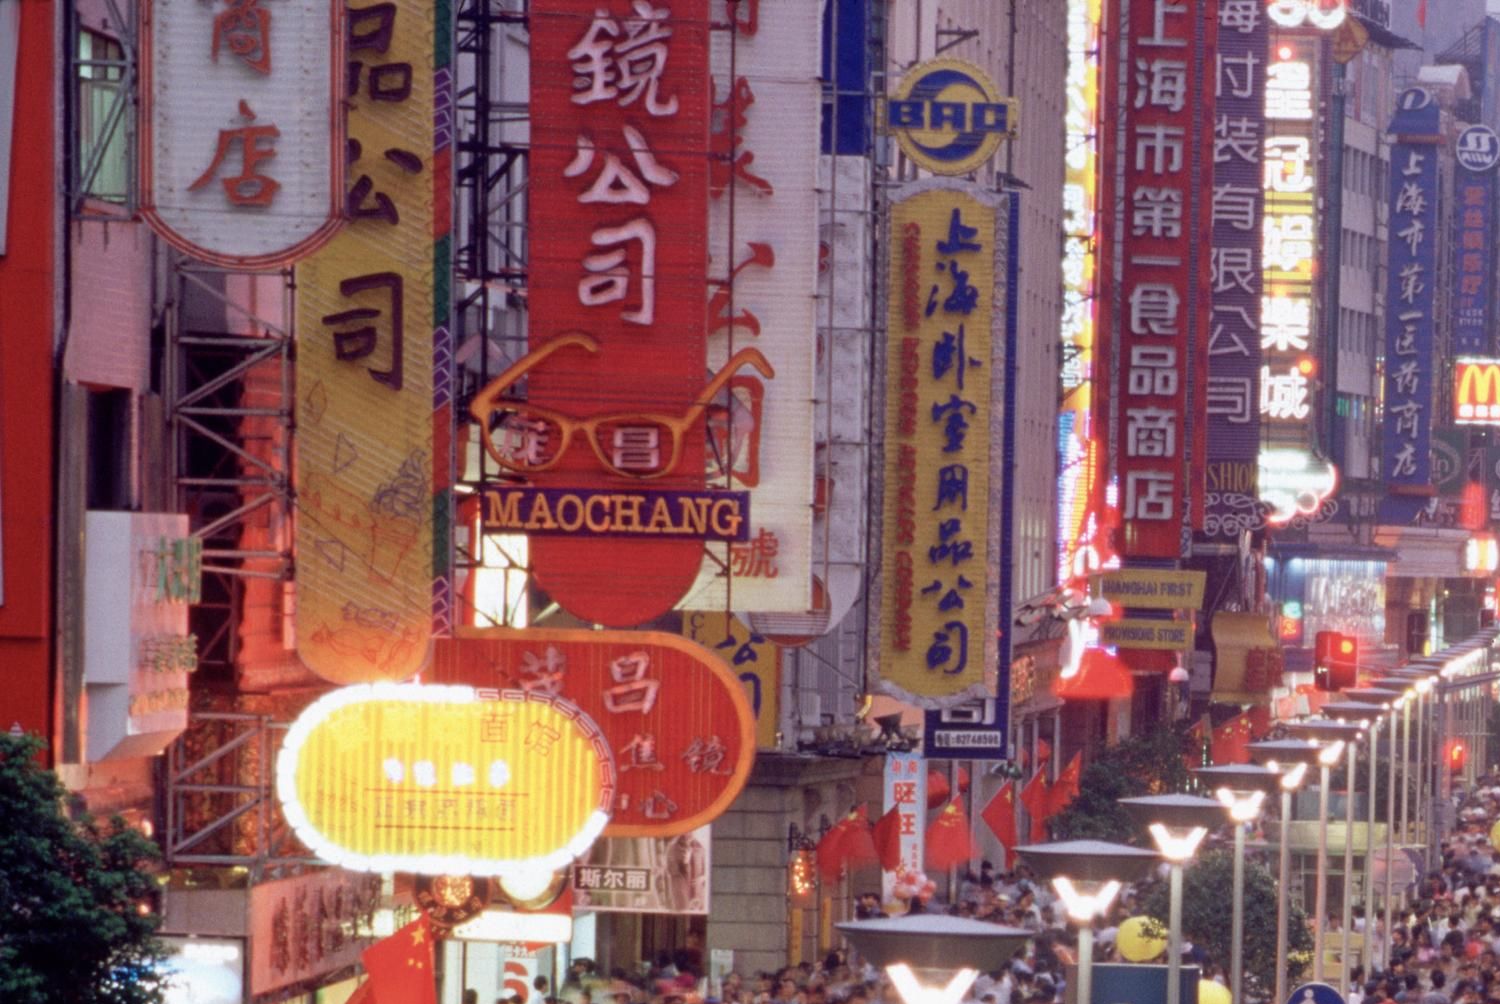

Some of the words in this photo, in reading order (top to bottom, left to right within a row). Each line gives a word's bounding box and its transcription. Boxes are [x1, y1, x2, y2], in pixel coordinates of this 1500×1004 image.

[563, 0, 681, 326] 鏡公司
[1123, 0, 1188, 521] 上海市第一食品商店
[484, 490, 743, 536] MAOCHANG
[1160, 581, 1193, 597] FIRST
[1157, 627, 1186, 643] STORE
[579, 867, 648, 889] 斯尔丽
